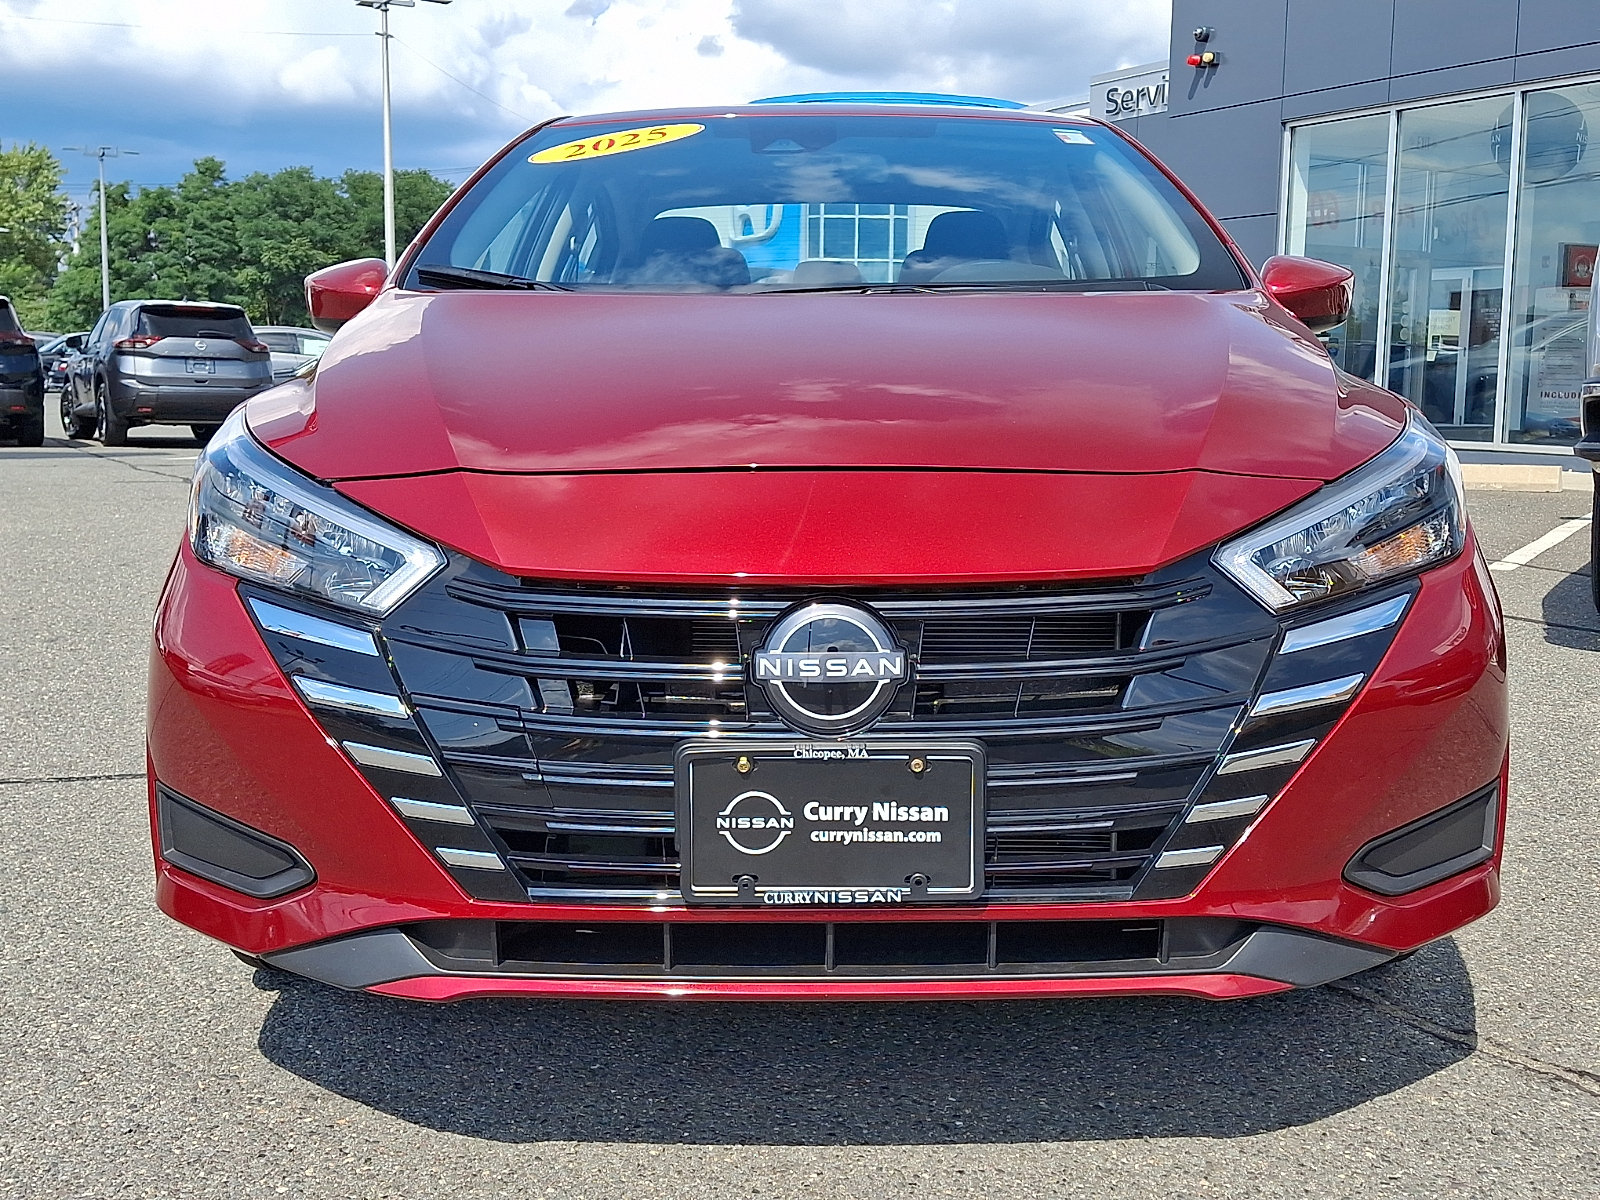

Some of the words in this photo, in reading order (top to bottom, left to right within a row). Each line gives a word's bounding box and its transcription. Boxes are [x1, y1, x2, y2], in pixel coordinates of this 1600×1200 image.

[565, 127, 667, 158] 2025
[759, 657, 901, 677] NISSAN
[793, 747, 845, 760] Chicopee,
[847, 748, 869, 759] MA
[803, 801, 868, 826] Curry
[871, 801, 949, 823] Nissan
[716, 817, 794, 829] NISSAN
[810, 828, 942, 845] currynissan.com
